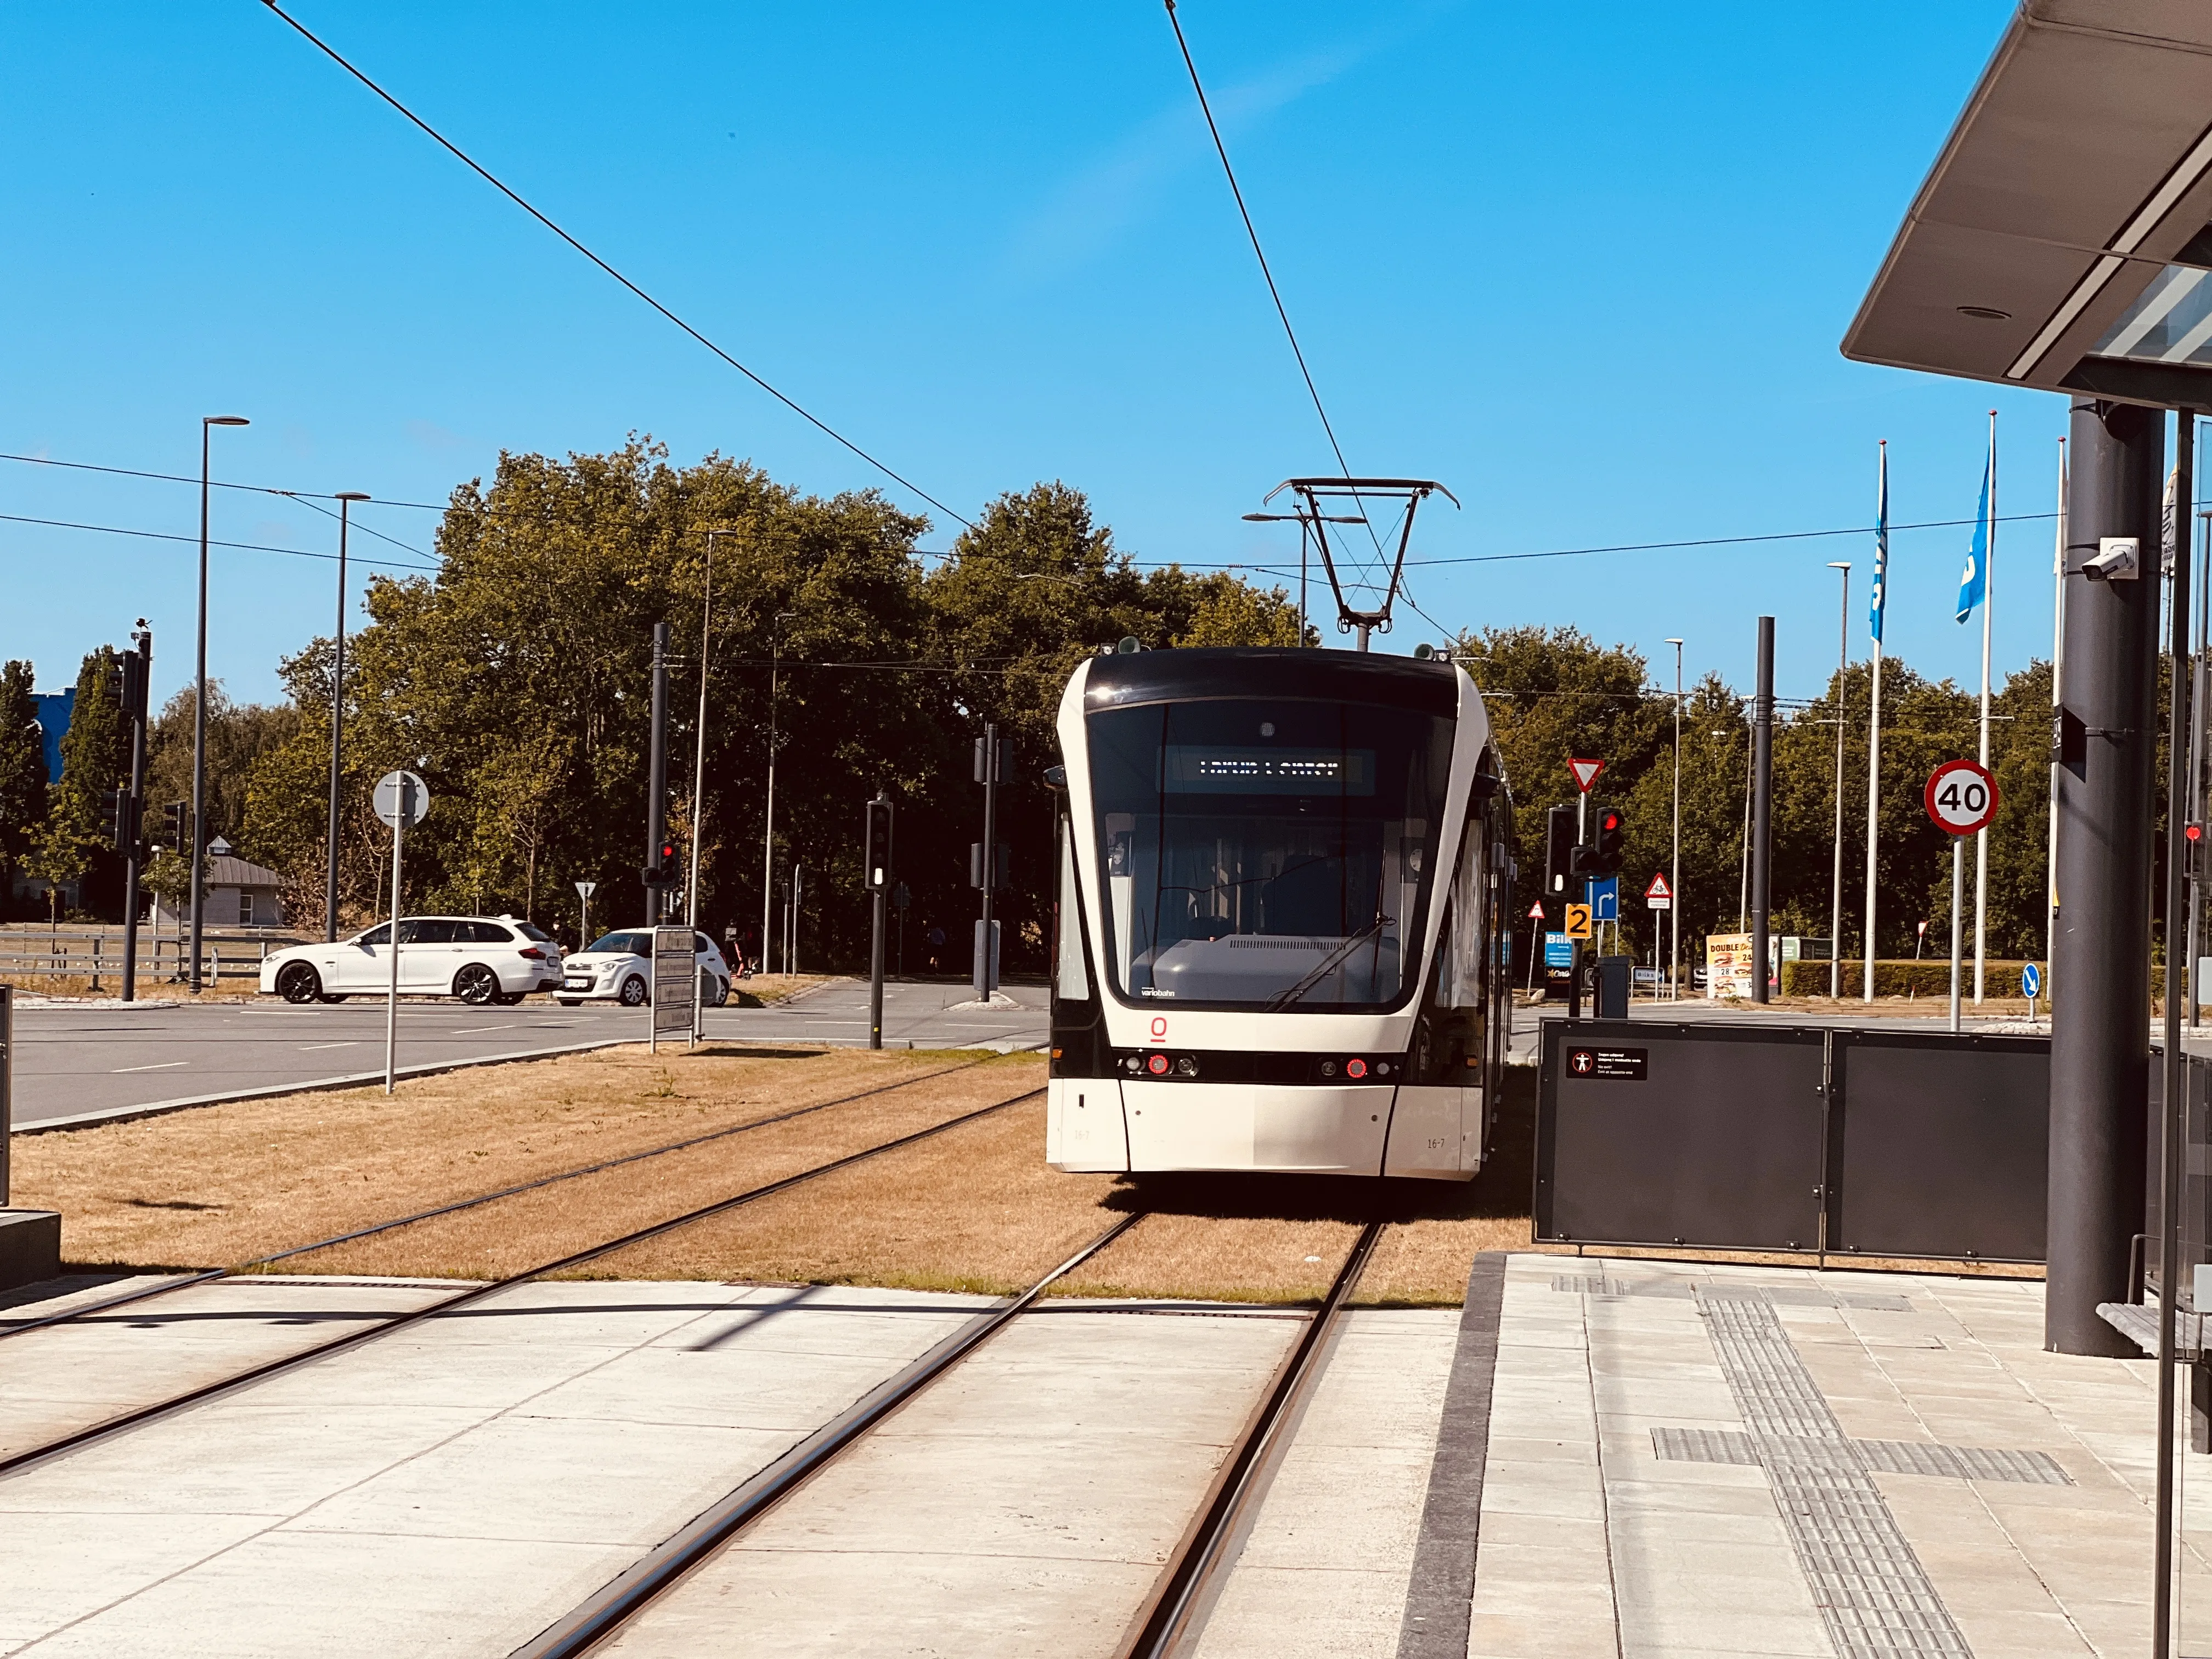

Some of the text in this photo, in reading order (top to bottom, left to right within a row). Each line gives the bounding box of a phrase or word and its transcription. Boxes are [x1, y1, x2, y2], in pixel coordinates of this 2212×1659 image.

[1938, 783, 1985, 812] 40
[1570, 910, 1587, 933] 2
[1547, 934, 1572, 944] Bilk
[1711, 944, 1739, 952] DOUBLE
[1427, 1138, 1445, 1149] 16-7
